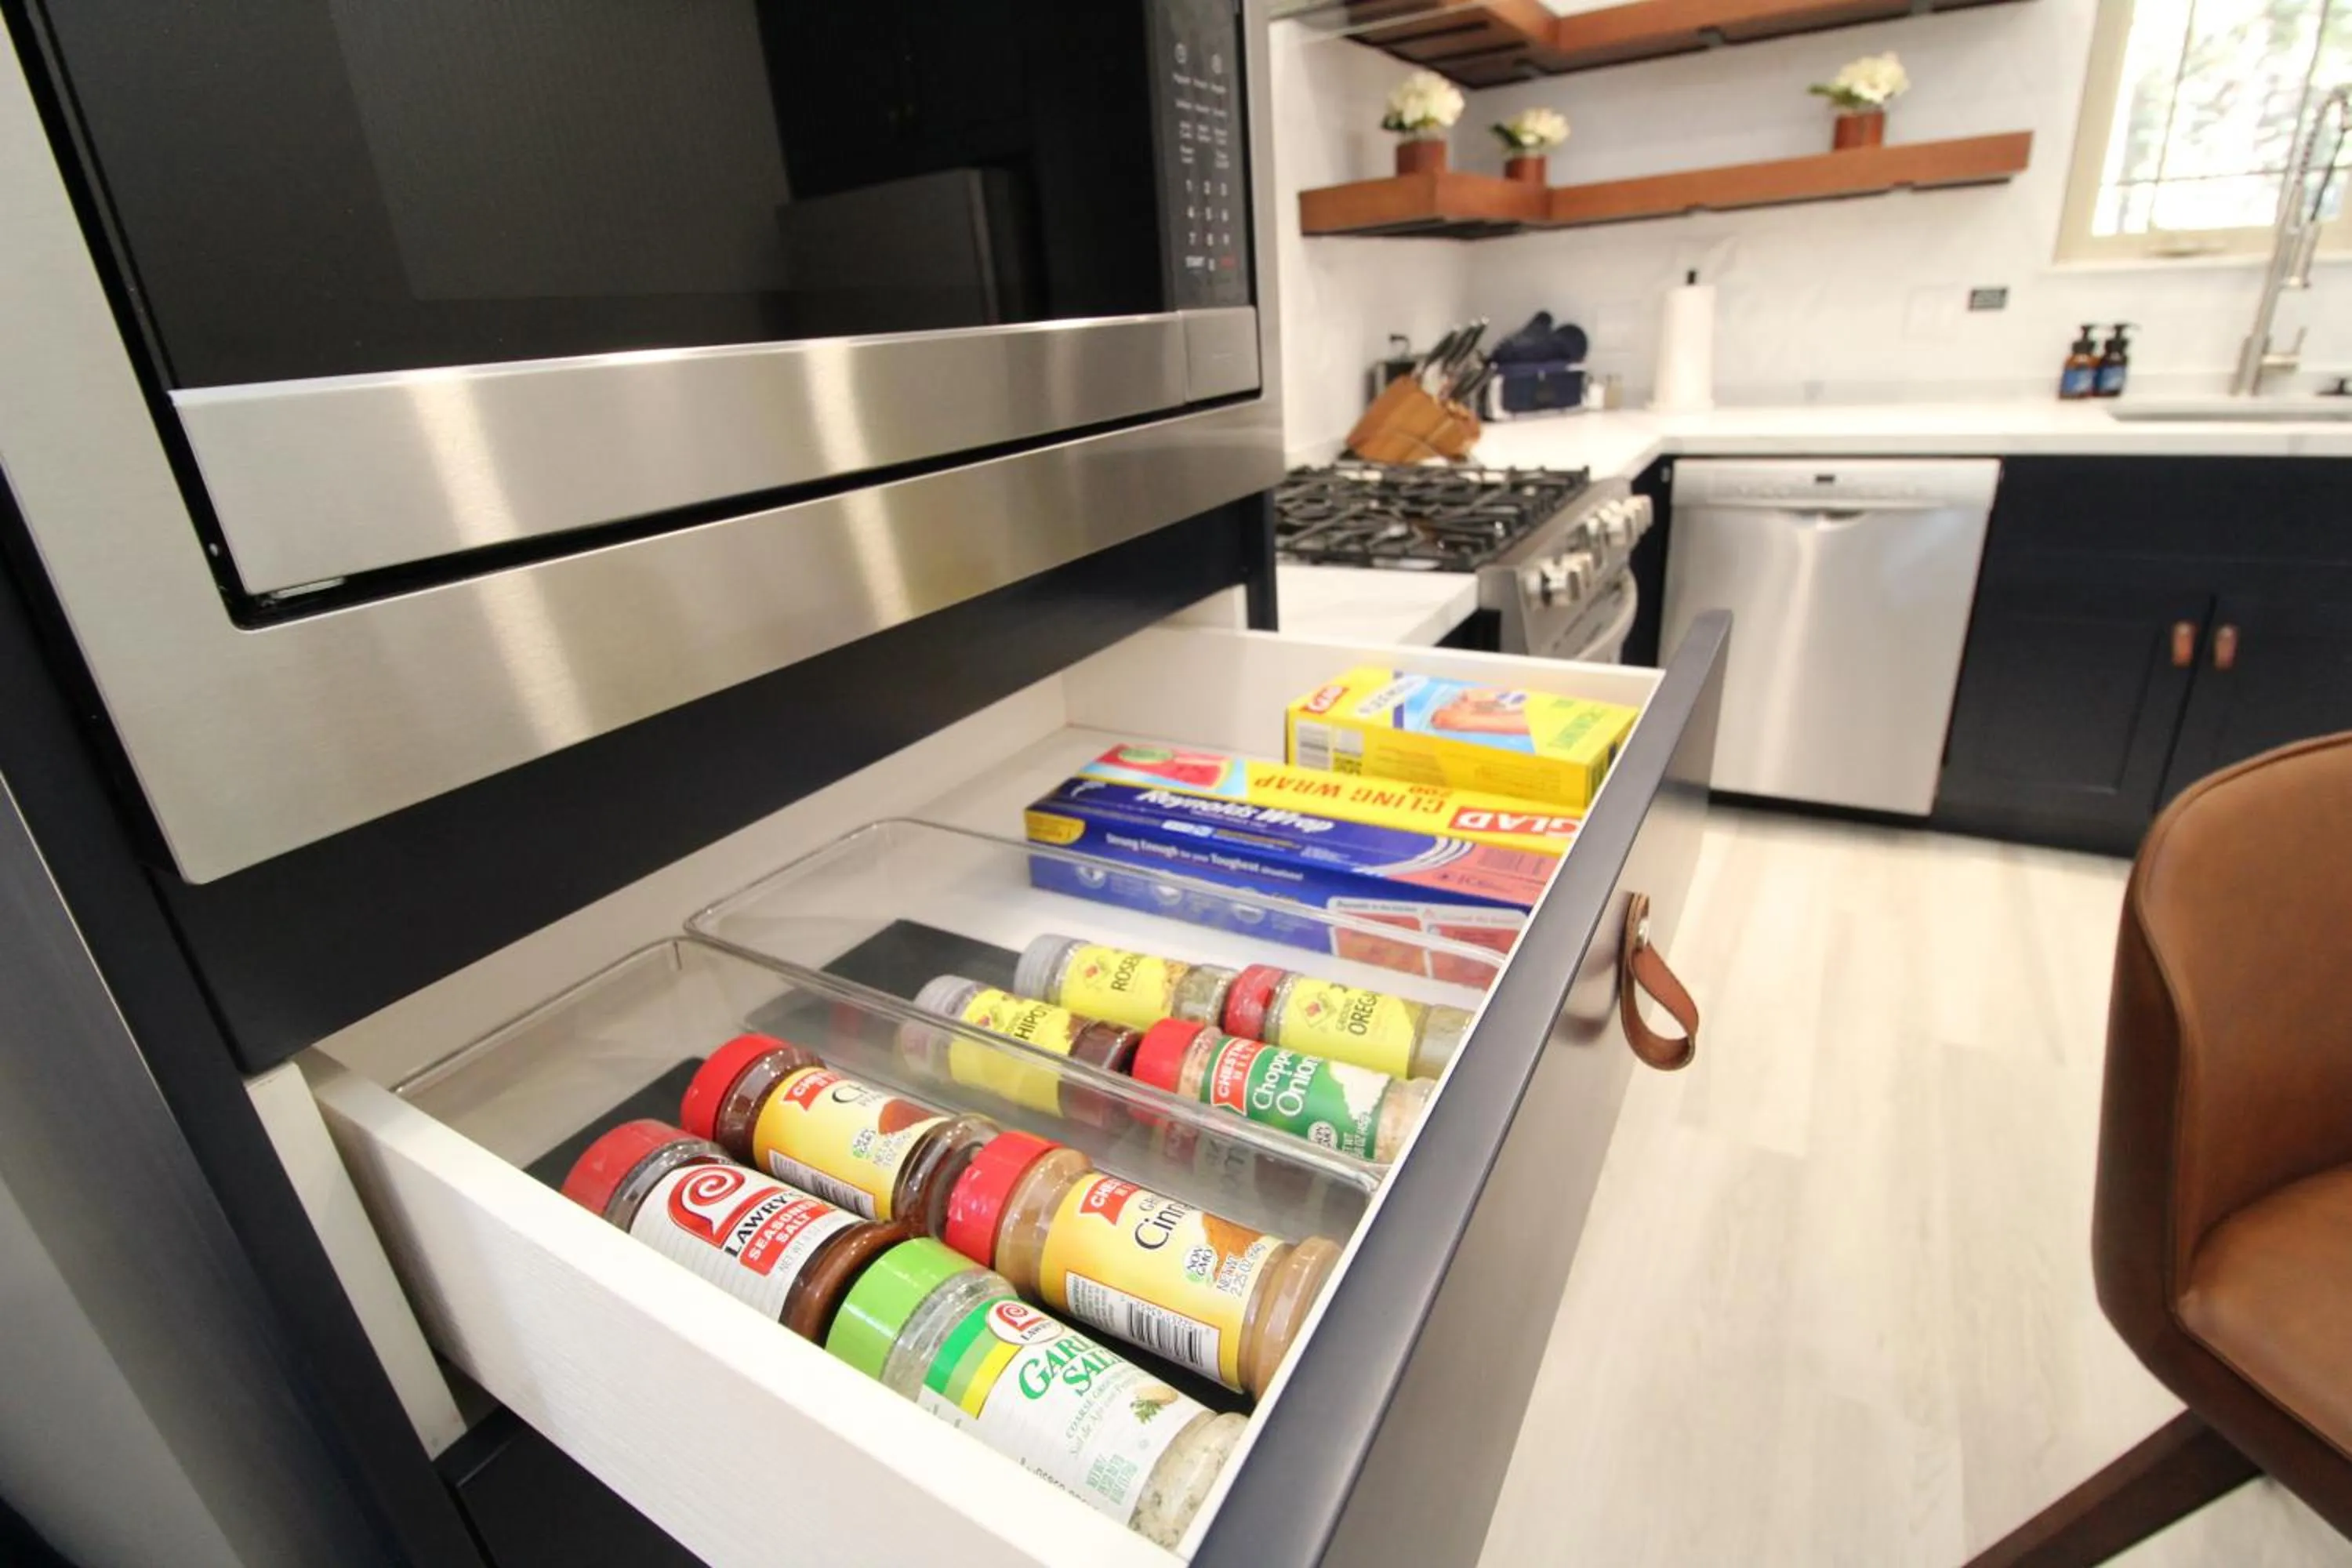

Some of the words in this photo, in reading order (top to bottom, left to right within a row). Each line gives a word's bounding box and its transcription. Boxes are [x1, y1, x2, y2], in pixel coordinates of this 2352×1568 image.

[1254, 775, 1341, 798] WRAP
[1349, 787, 1446, 815] CLING
[1457, 810, 1582, 837] GLAD
[775, 1211, 811, 1243] SALT
[1134, 1201, 1191, 1250] Cinn
